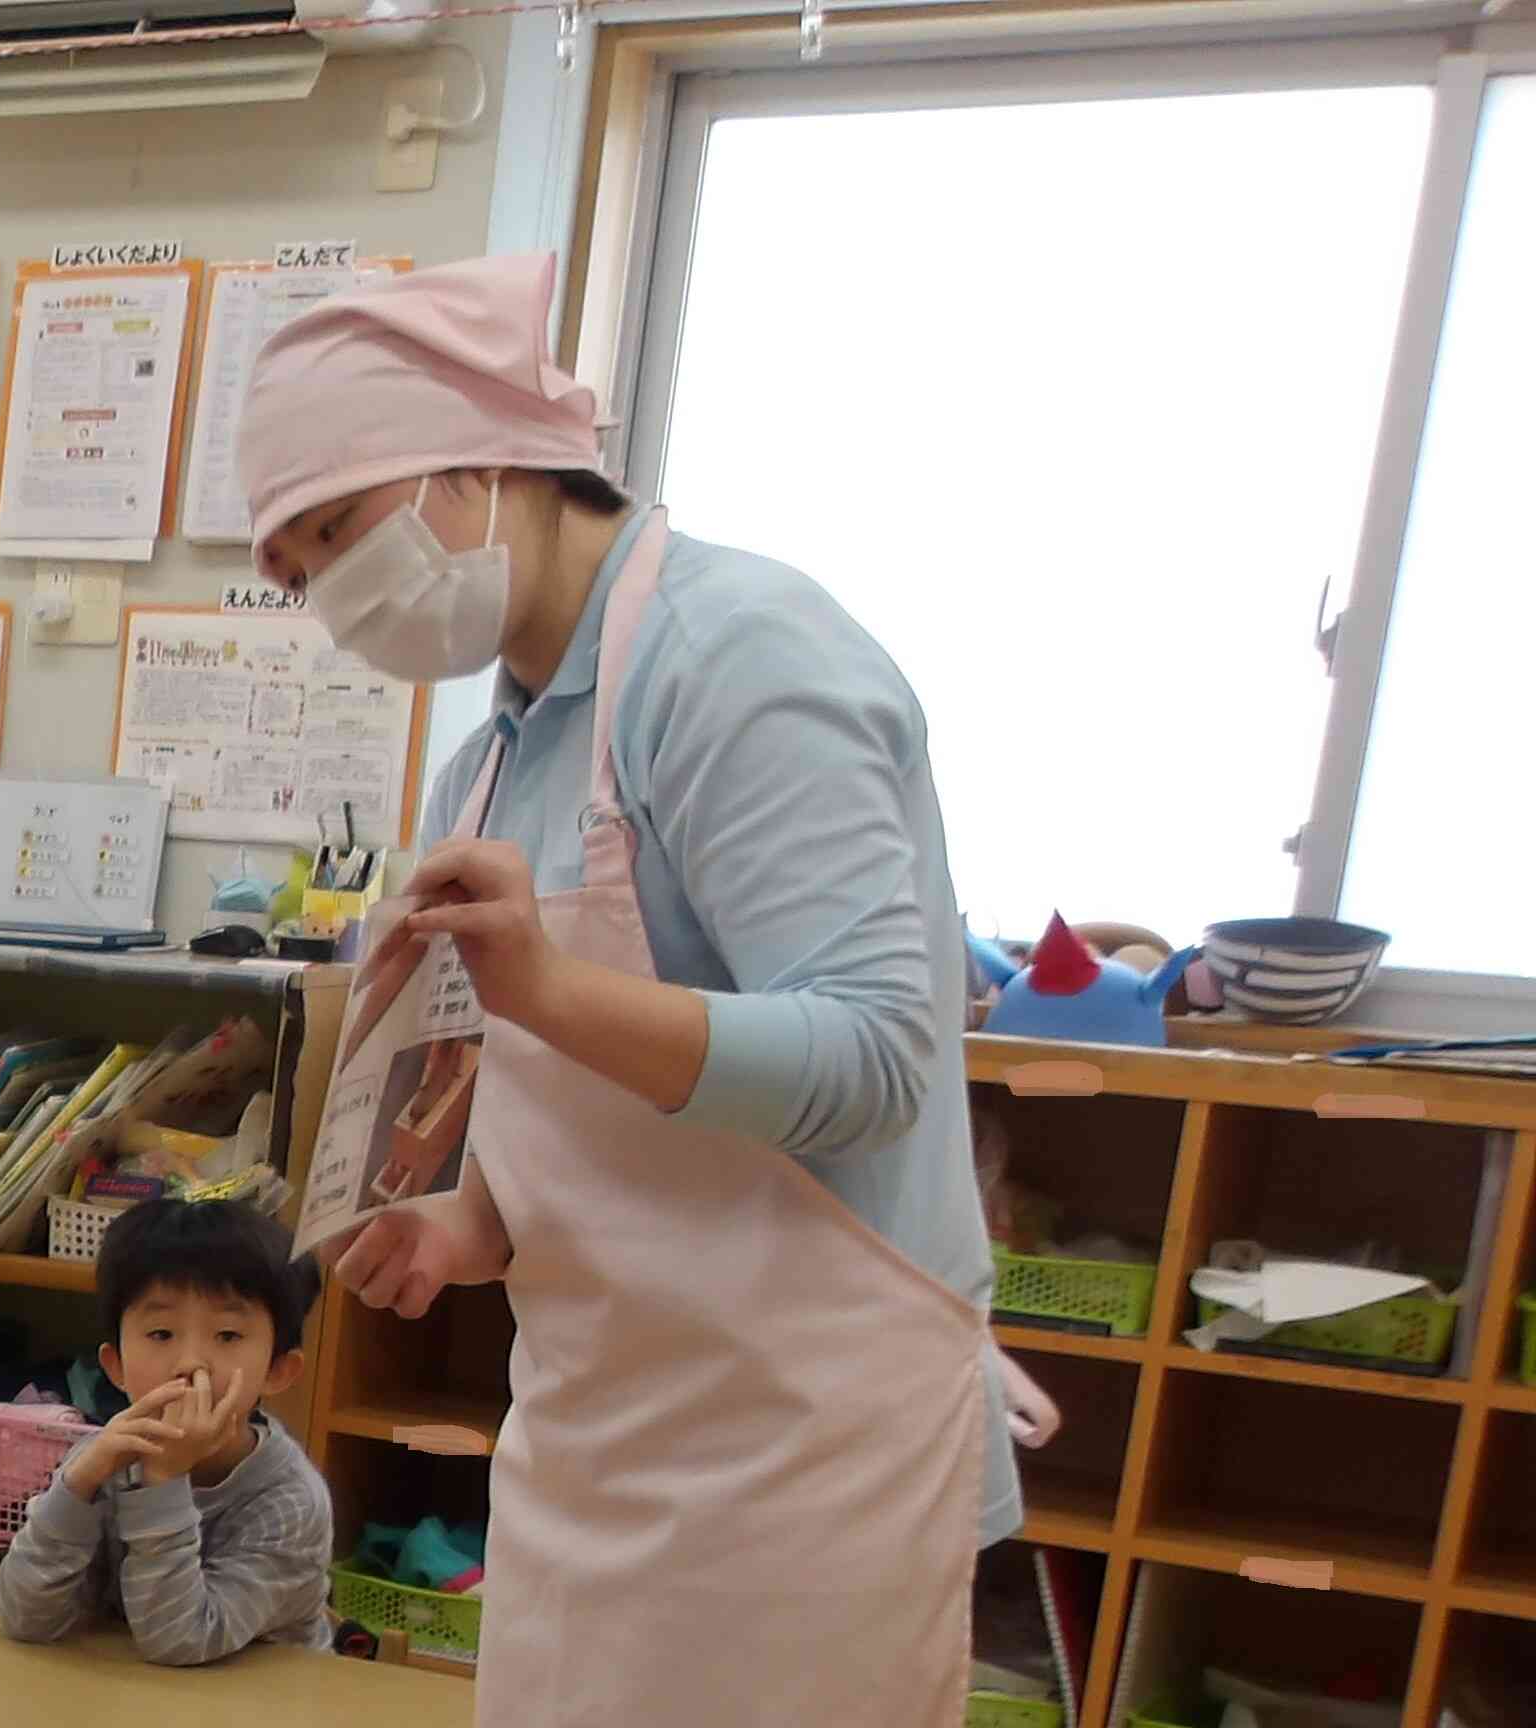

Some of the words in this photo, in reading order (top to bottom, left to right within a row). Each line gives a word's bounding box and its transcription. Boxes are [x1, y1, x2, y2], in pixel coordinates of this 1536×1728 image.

[54, 243, 177, 265] しょくいくだより
[277, 247, 351, 266] こんだて
[224, 588, 306, 610] えんだより
